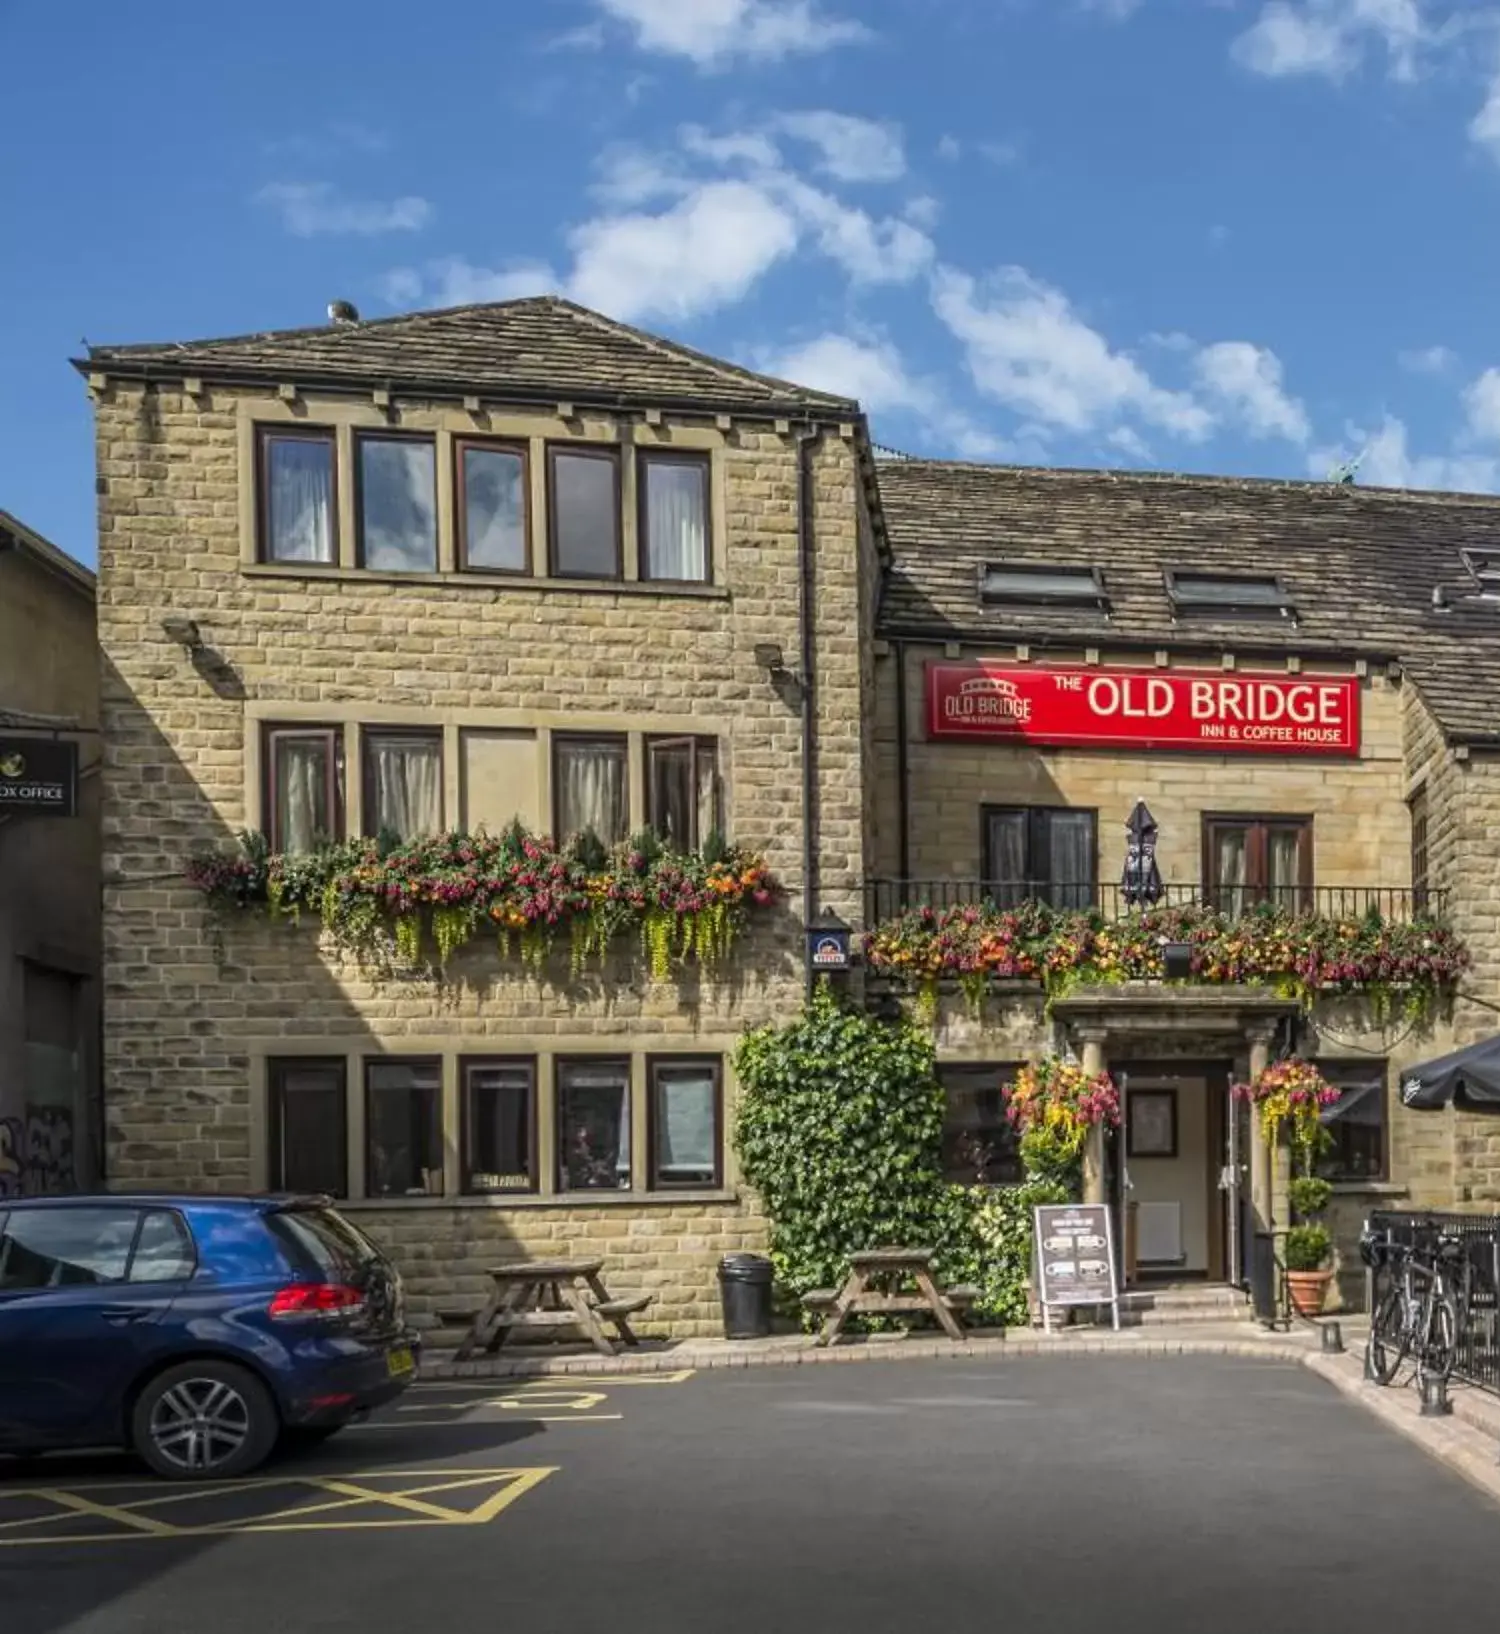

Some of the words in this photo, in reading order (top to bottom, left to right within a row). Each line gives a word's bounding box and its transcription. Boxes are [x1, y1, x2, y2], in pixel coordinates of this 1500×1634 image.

[945, 695, 973, 716] OLD
[978, 696, 1033, 721] BRIDGE
[1053, 676, 1082, 691] THE
[1087, 678, 1174, 717] OLD
[1190, 682, 1342, 724] BRIDGE
[1200, 725, 1224, 738] INN
[1229, 727, 1239, 739] &
[1243, 727, 1293, 740] COFFEE
[1297, 728, 1342, 742] HOUSE
[19, 787, 63, 799] OFFICE
